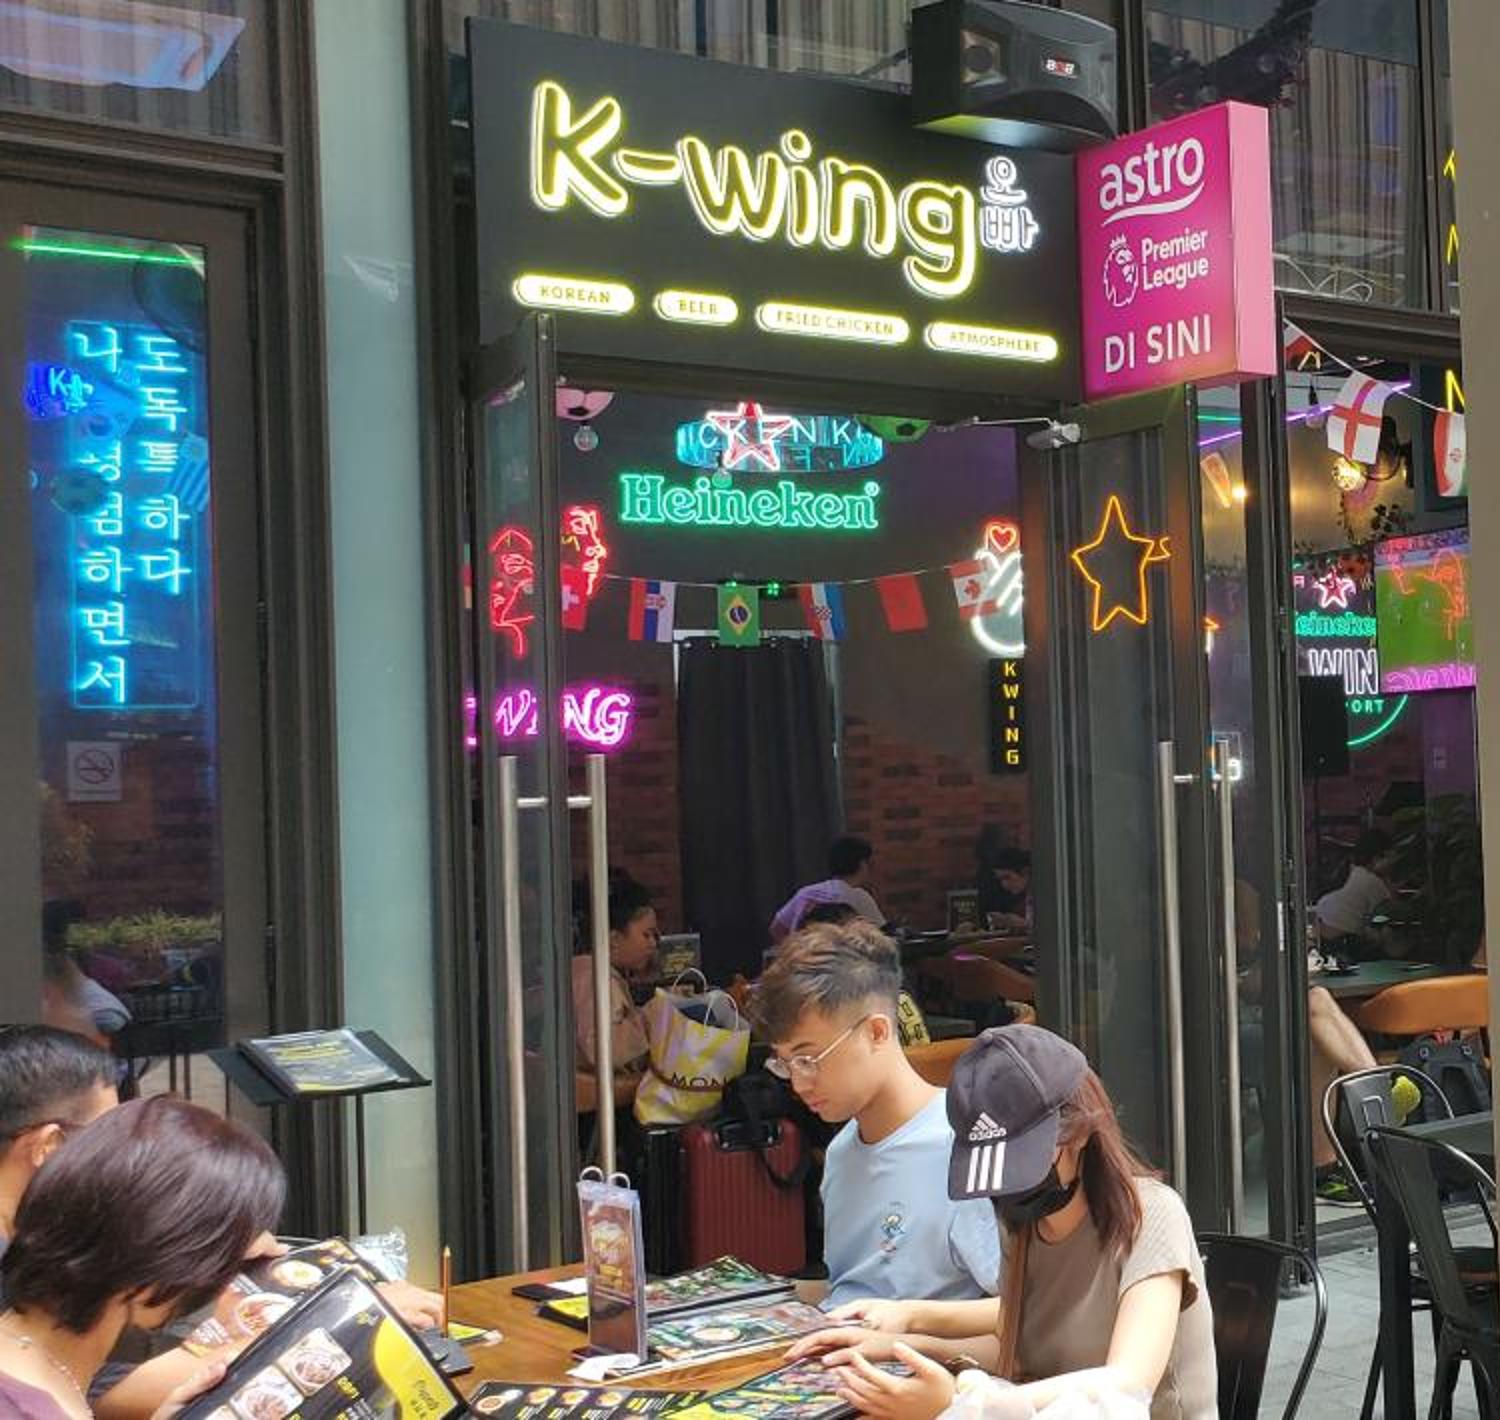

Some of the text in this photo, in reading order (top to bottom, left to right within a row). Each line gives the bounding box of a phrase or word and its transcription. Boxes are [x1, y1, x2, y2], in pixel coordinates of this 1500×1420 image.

[532, 80, 977, 297] K-wing
[1099, 137, 1206, 212] astro
[1141, 227, 1210, 265] Premier
[1142, 256, 1210, 292] League
[538, 283, 612, 304] KOREAN
[677, 297, 719, 316] BEER
[775, 307, 895, 337] FRIED CHICKEN
[949, 329, 1041, 353] ATMOSPHERE
[1104, 313, 1213, 375] DI SINI
[619, 474, 880, 529] Heineken
[1002, 660, 1020, 765] KWING
[1345, 699, 1386, 714] ORT
